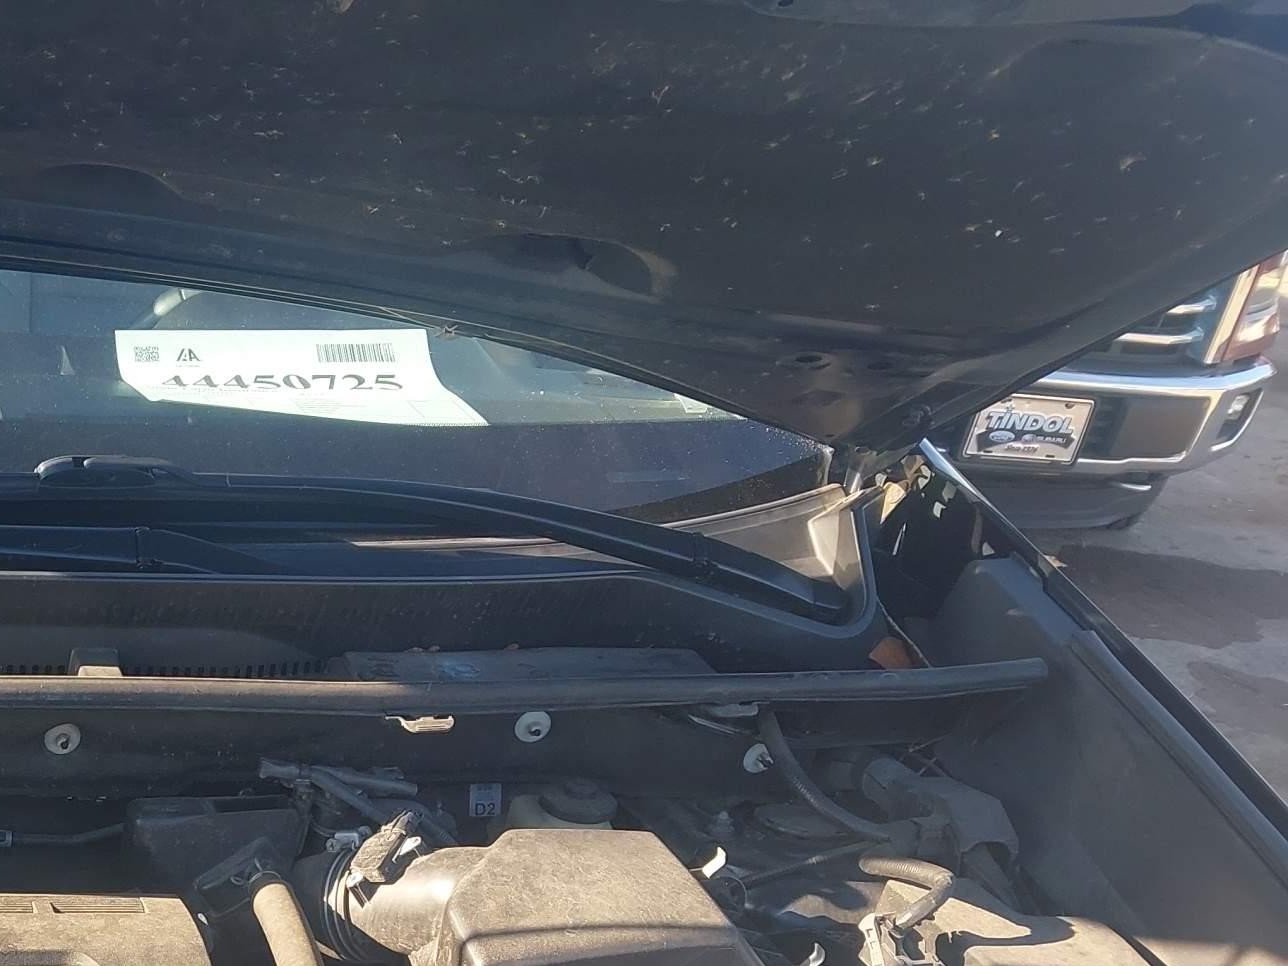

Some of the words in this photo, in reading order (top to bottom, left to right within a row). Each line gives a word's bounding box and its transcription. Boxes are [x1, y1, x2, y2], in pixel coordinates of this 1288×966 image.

[161, 373, 404, 391] 44450725
[988, 411, 1074, 433] TINDOL
[475, 802, 496, 816] D2
